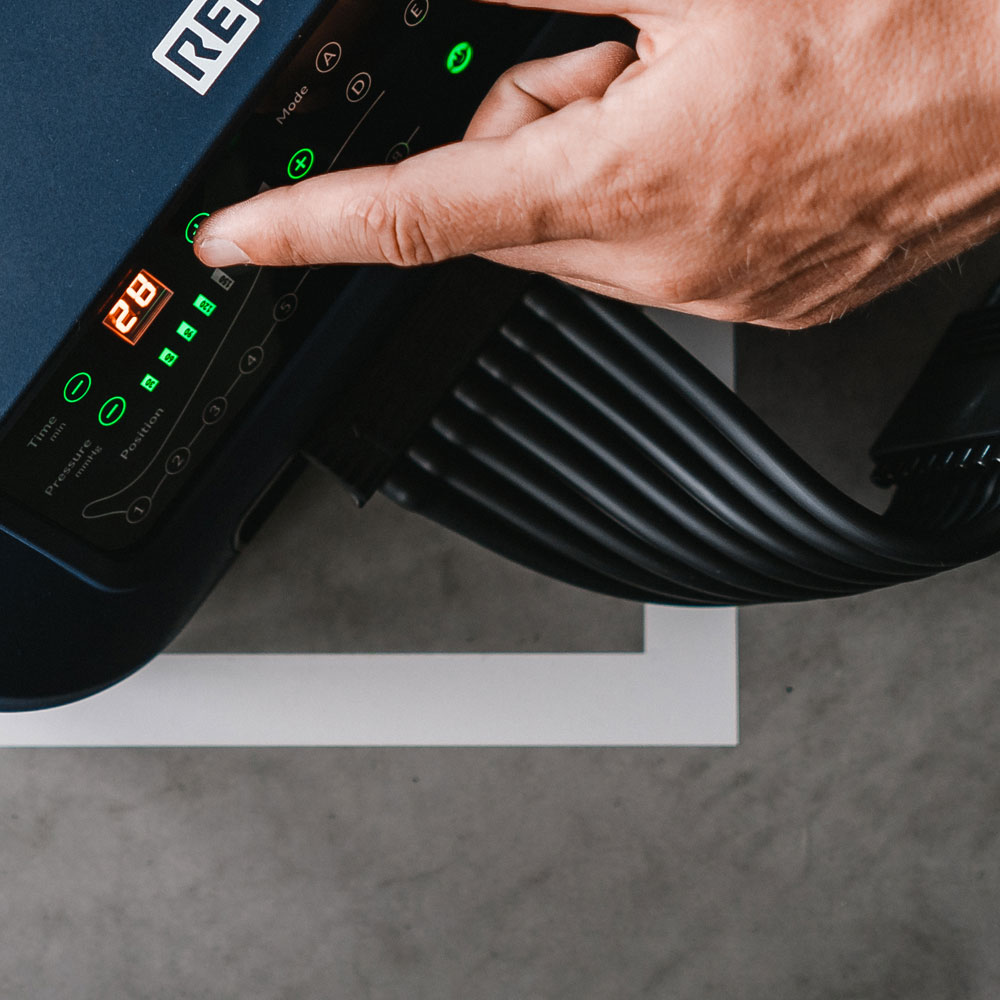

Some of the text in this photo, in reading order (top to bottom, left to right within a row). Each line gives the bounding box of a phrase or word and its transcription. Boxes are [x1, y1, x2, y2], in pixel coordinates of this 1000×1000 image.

[351, 3, 423, 95] D E
[276, 85, 309, 124] Mode
[323, 51, 336, 66] A
[109, 273, 157, 334] 28
[199, 300, 213, 314] 120
[184, 327, 195, 339] 90
[164, 352, 175, 363] 60
[145, 378, 155, 388] 30
[171, 455, 183, 467] 2
[209, 404, 221, 417] 3
[247, 354, 257, 366] 4
[279, 303, 292, 313] 5
[26, 416, 57, 448] Time
[50, 422, 67, 442] min
[120, 407, 165, 459] Position
[44, 439, 92, 496] Pressure
[75, 445, 102, 478] mmHg
